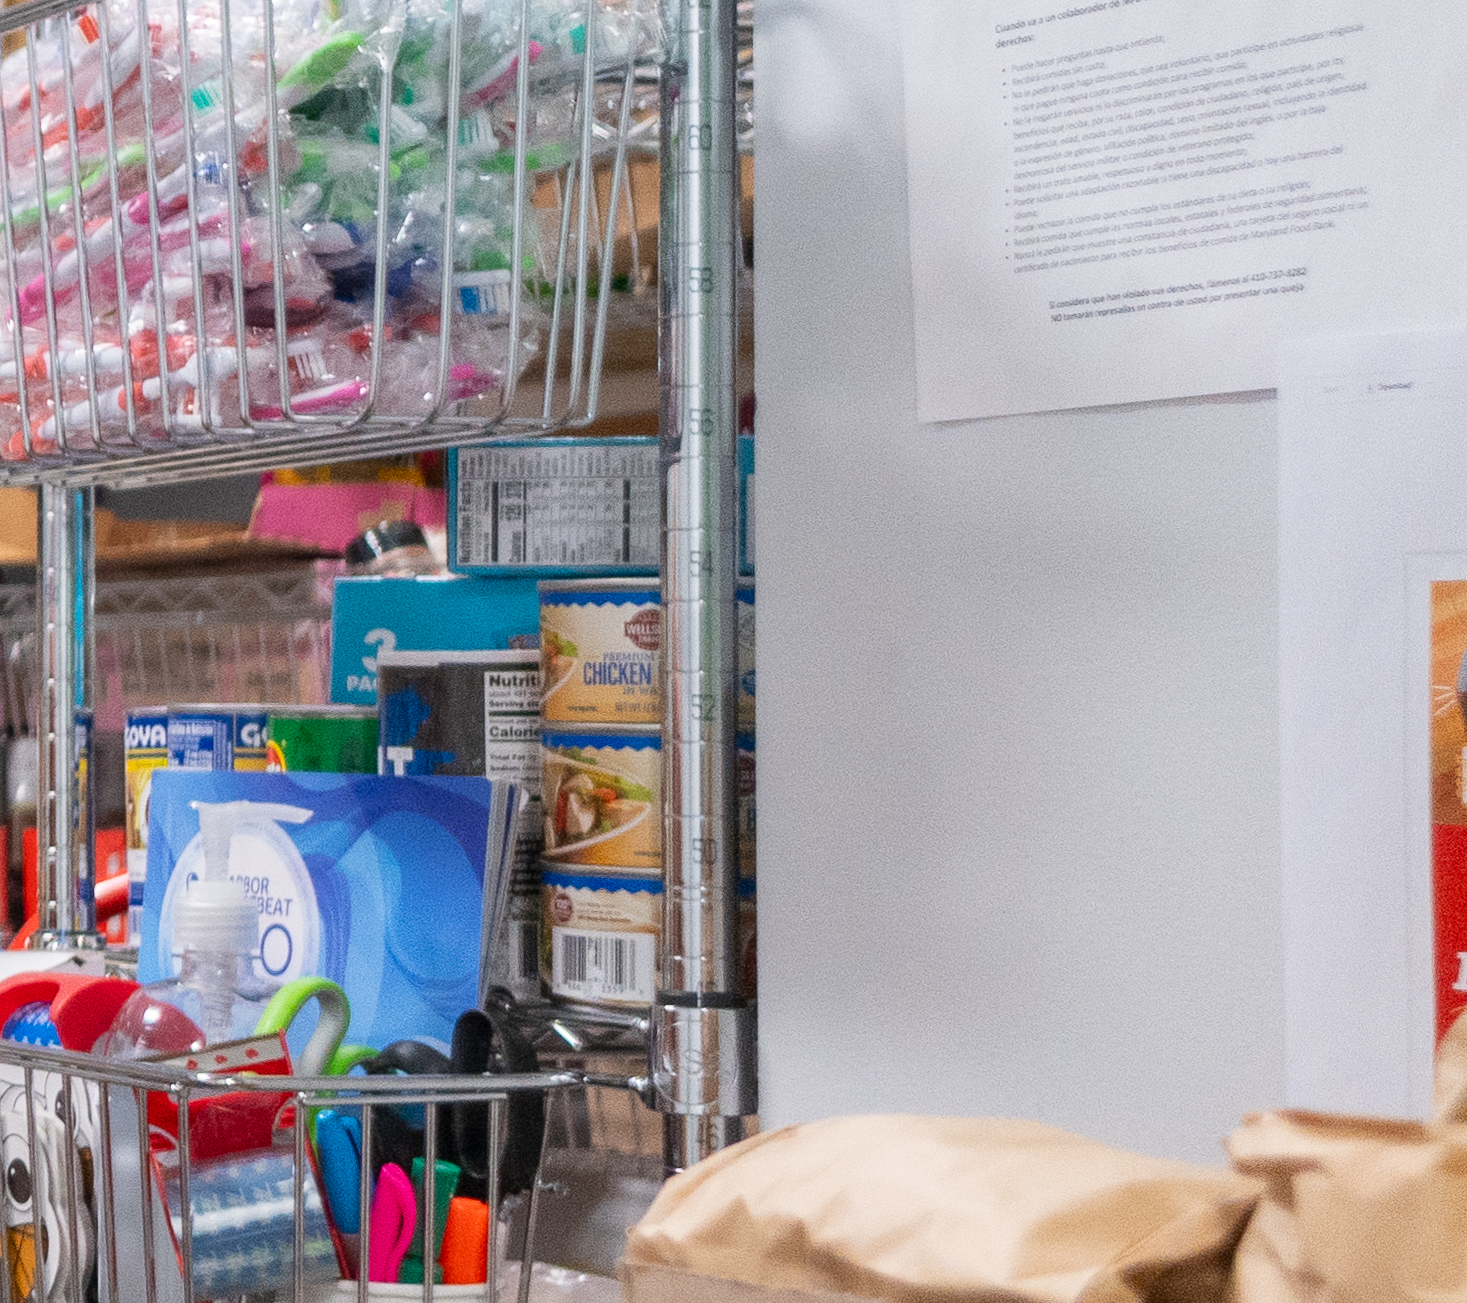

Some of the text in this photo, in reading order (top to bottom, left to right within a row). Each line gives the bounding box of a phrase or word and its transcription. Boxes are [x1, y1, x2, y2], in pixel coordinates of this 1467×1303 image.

[995, 18, 1025, 33] Cuando
[690, 550, 713, 577] 54
[361, 627, 397, 673] 3
[583, 662, 652, 686] CHICKEN
[691, 694, 715, 721] 52
[692, 837, 717, 865] 50
